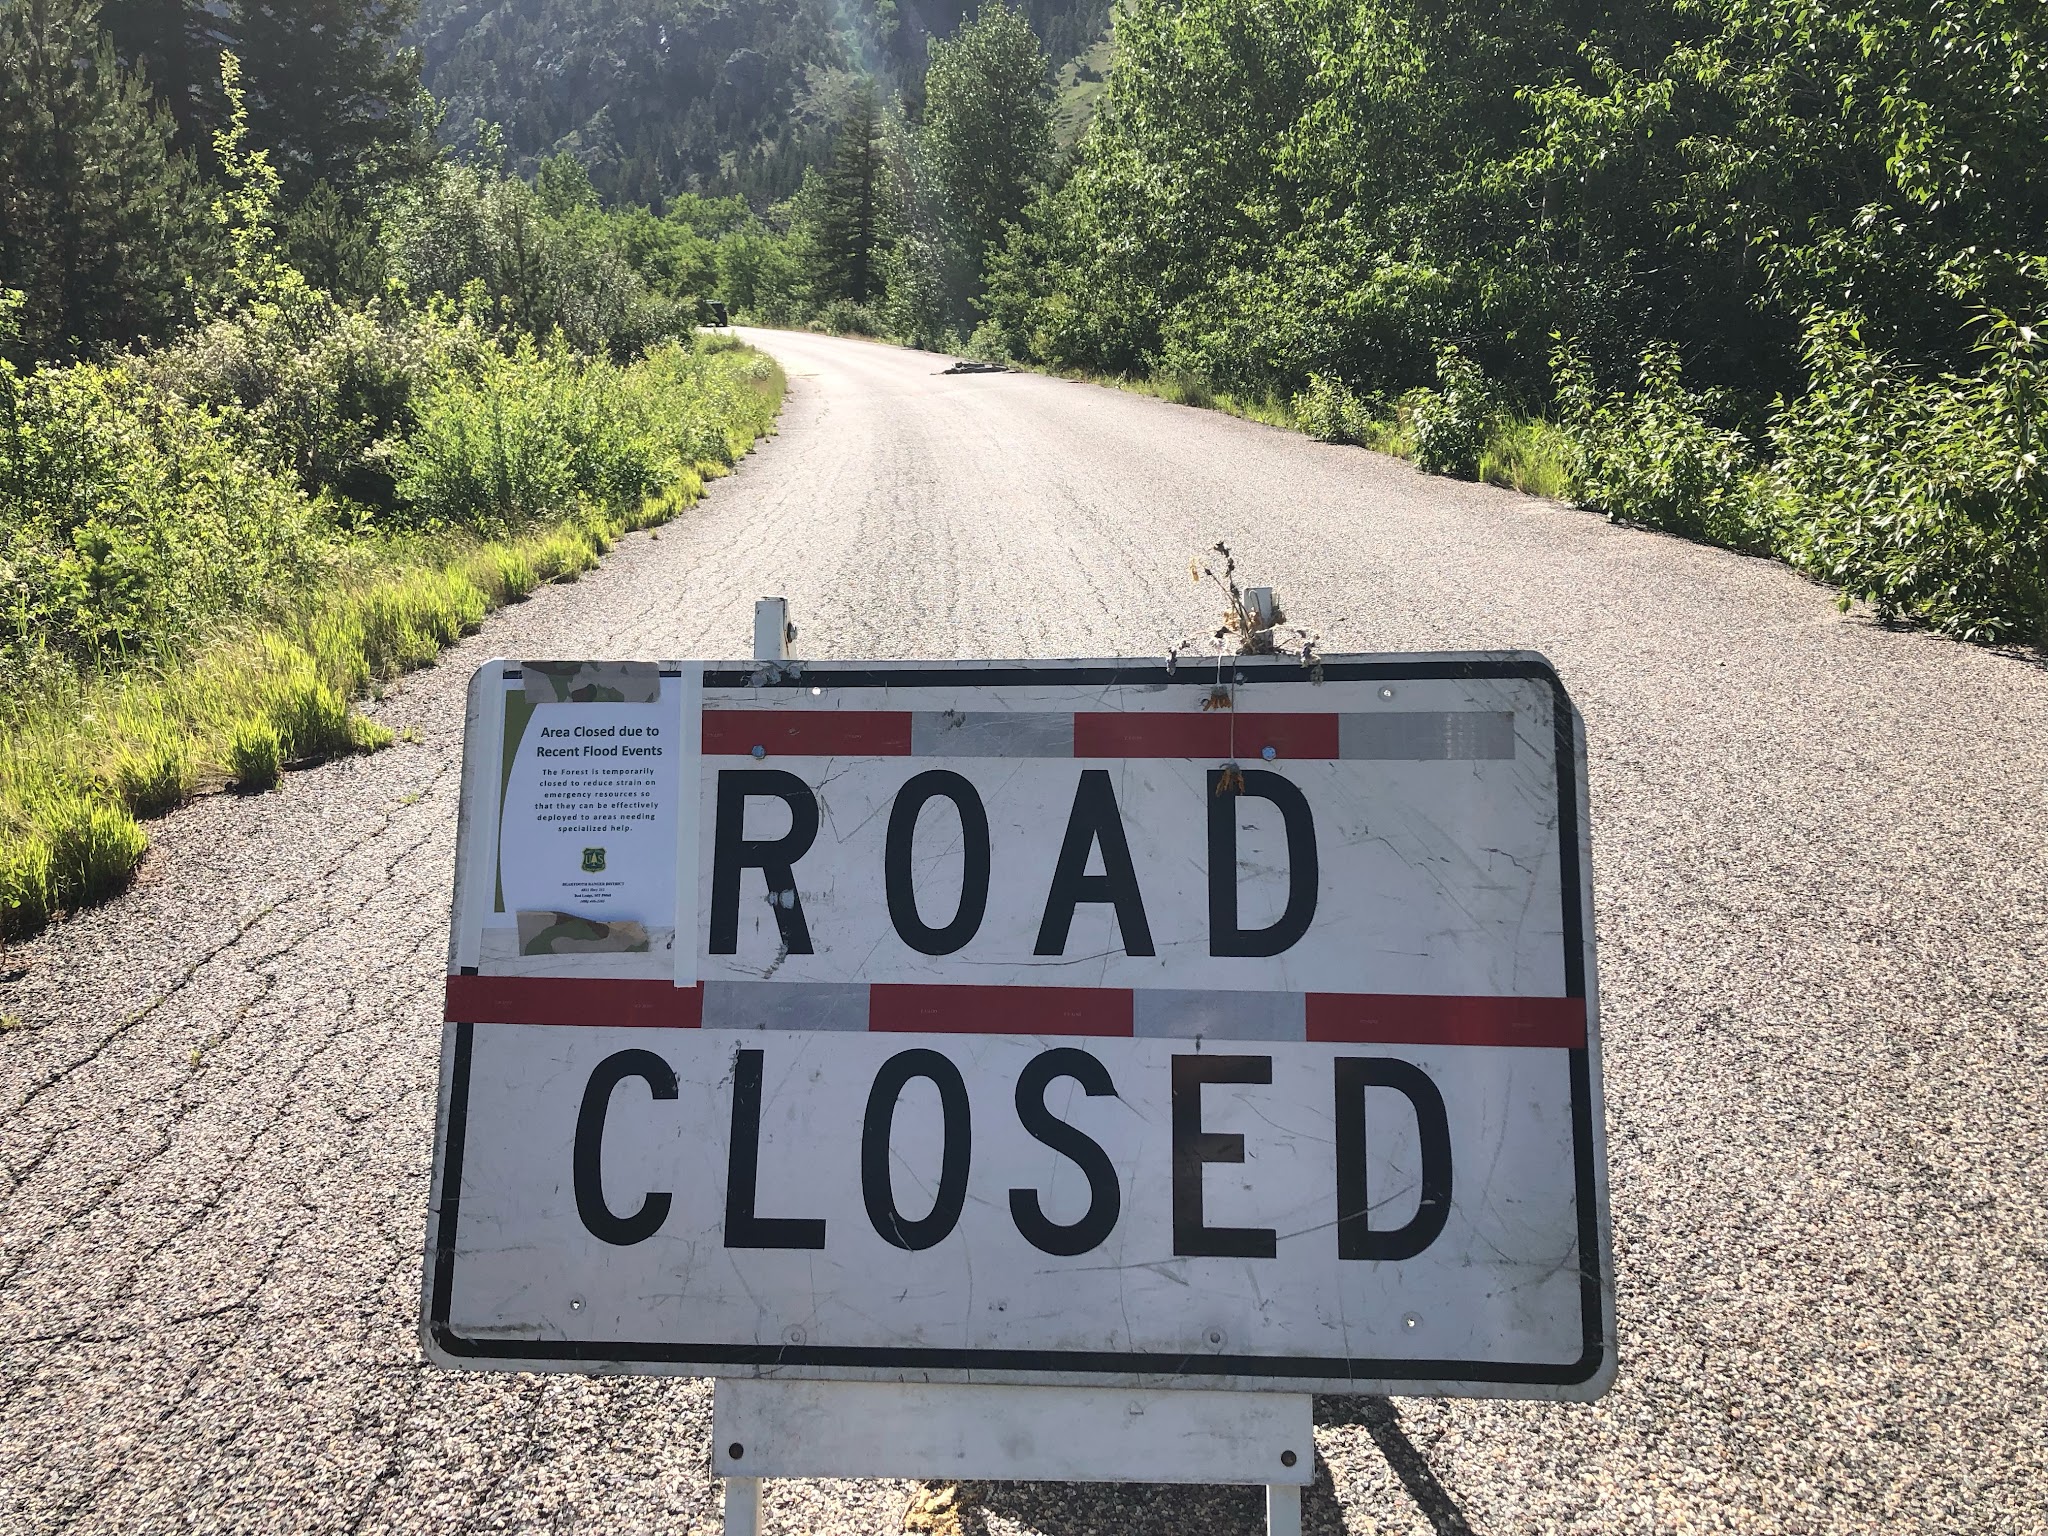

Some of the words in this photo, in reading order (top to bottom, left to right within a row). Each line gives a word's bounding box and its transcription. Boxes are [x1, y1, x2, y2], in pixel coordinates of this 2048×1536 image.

[540, 727, 570, 738] Area
[573, 725, 615, 737] Closed
[619, 725, 643, 737] due
[646, 726, 659, 737] to
[537, 746, 580, 757] Recent
[583, 745, 618, 757] Flood
[622, 745, 663, 756] Events
[542, 769, 558, 777] The
[561, 768, 588, 776] Forest
[592, 768, 599, 776] is
[602, 767, 654, 777] temporarily
[539, 780, 567, 788] closed
[571, 780, 580, 788] to
[583, 779, 613, 787] reduce
[544, 792, 592, 800] emergency
[641, 790, 650, 798] so
[534, 803, 553, 811] that
[556, 802, 576, 811] they
[597, 802, 608, 810] be
[611, 801, 659, 811] effectively
[537, 814, 577, 823] deployed
[620, 813, 655, 822] needing
[558, 825, 607, 834] specialized
[610, 825, 632, 834] help.
[708, 768, 1318, 957] ROAD
[573, 1048, 1452, 1261] CLOSED
